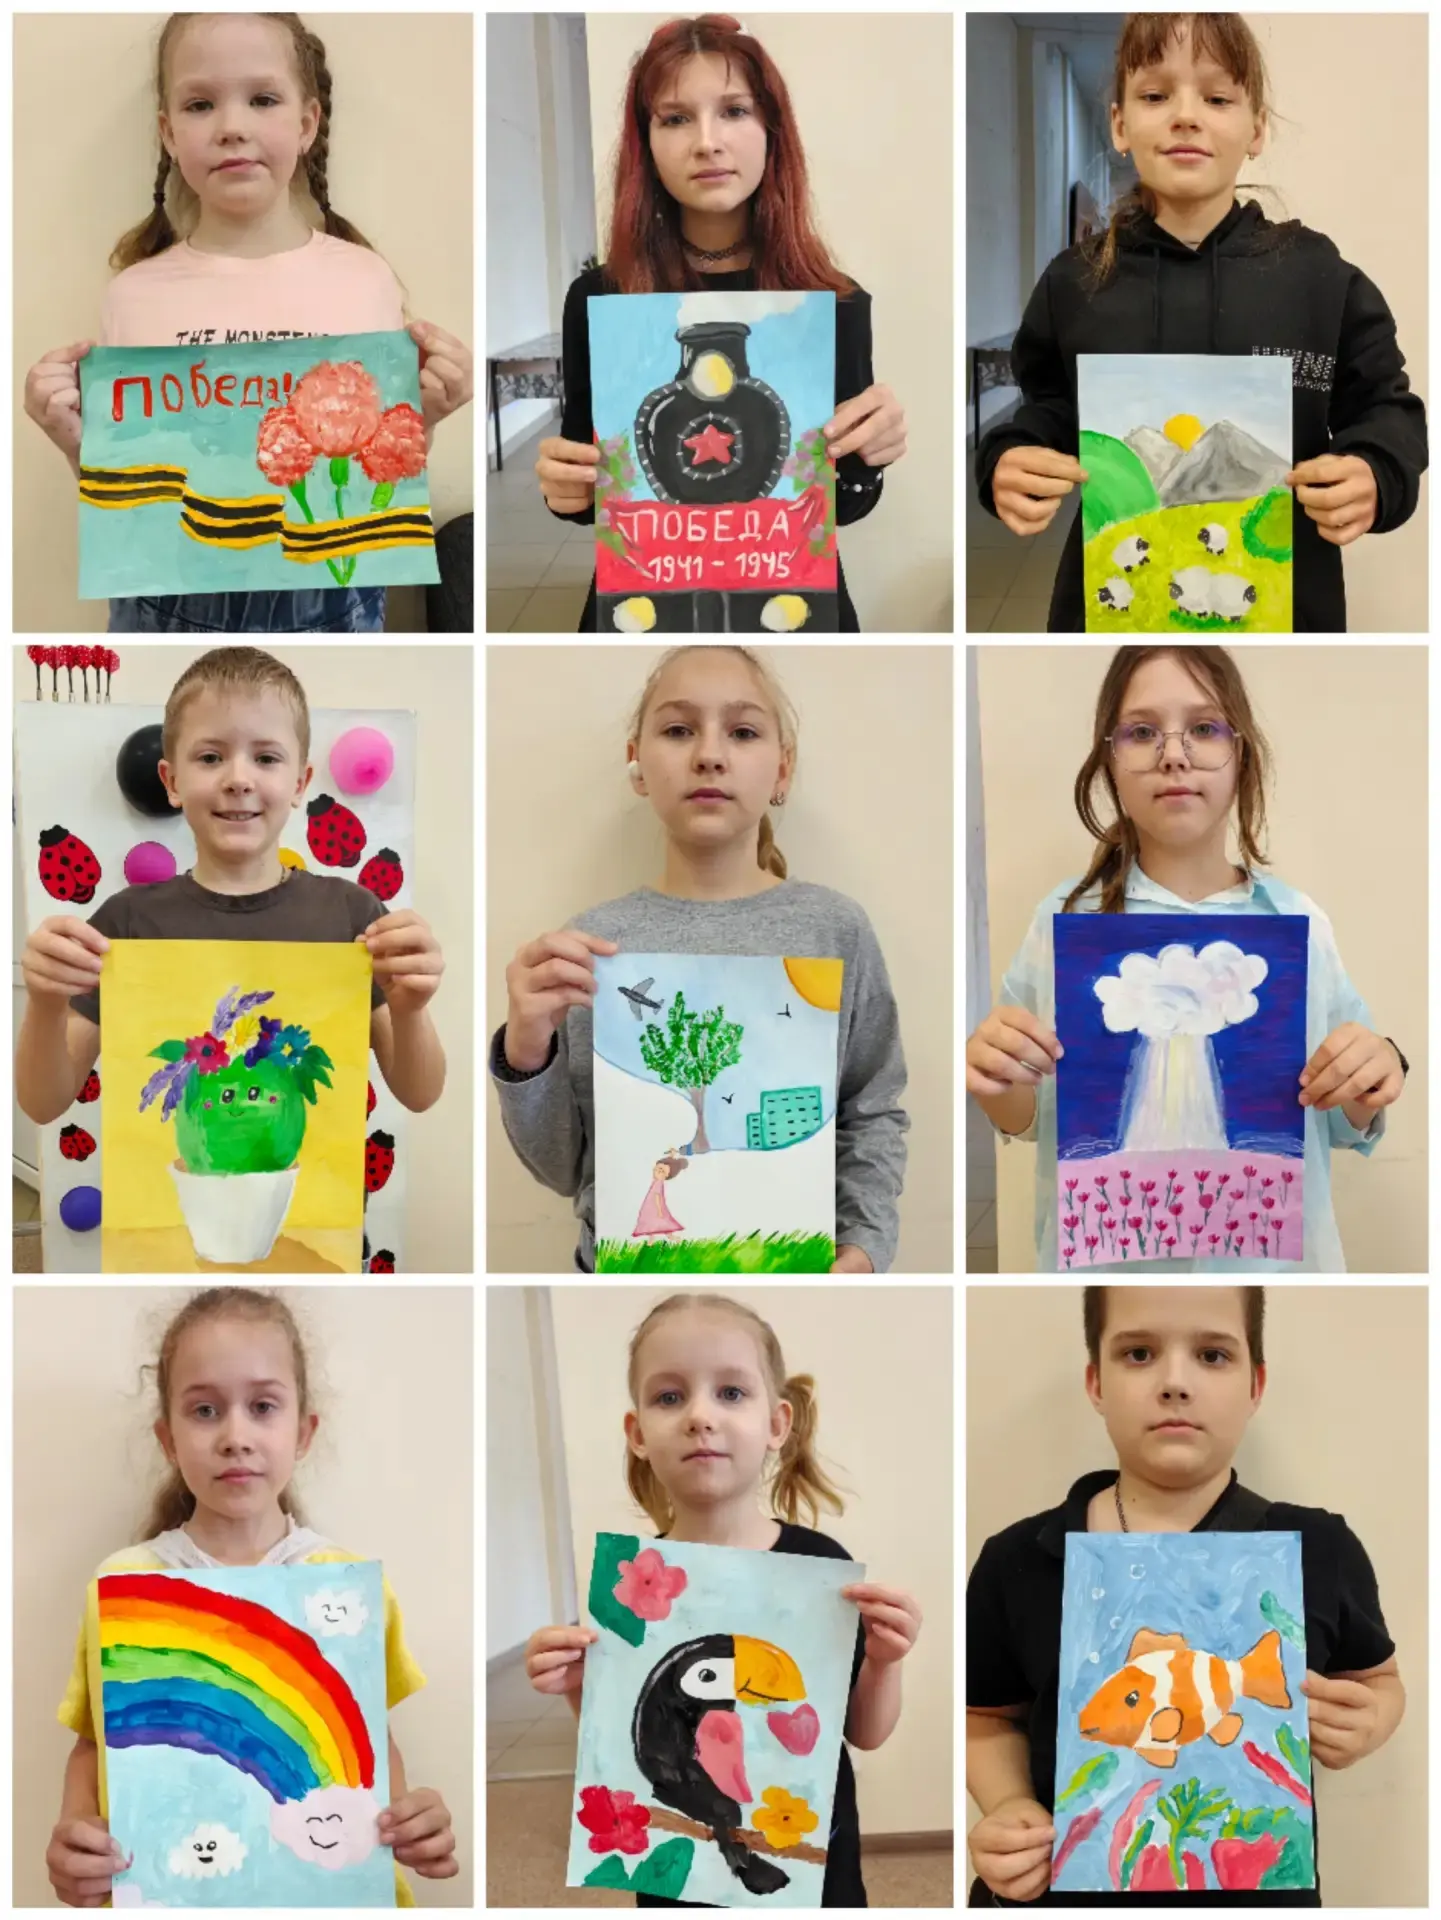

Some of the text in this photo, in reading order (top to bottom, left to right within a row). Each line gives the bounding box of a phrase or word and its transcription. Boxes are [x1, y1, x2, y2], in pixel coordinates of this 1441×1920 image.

[616, 508, 790, 543] ПОБЕДА
[648, 555, 704, 583] 1941
[735, 551, 792, 579] 1945
